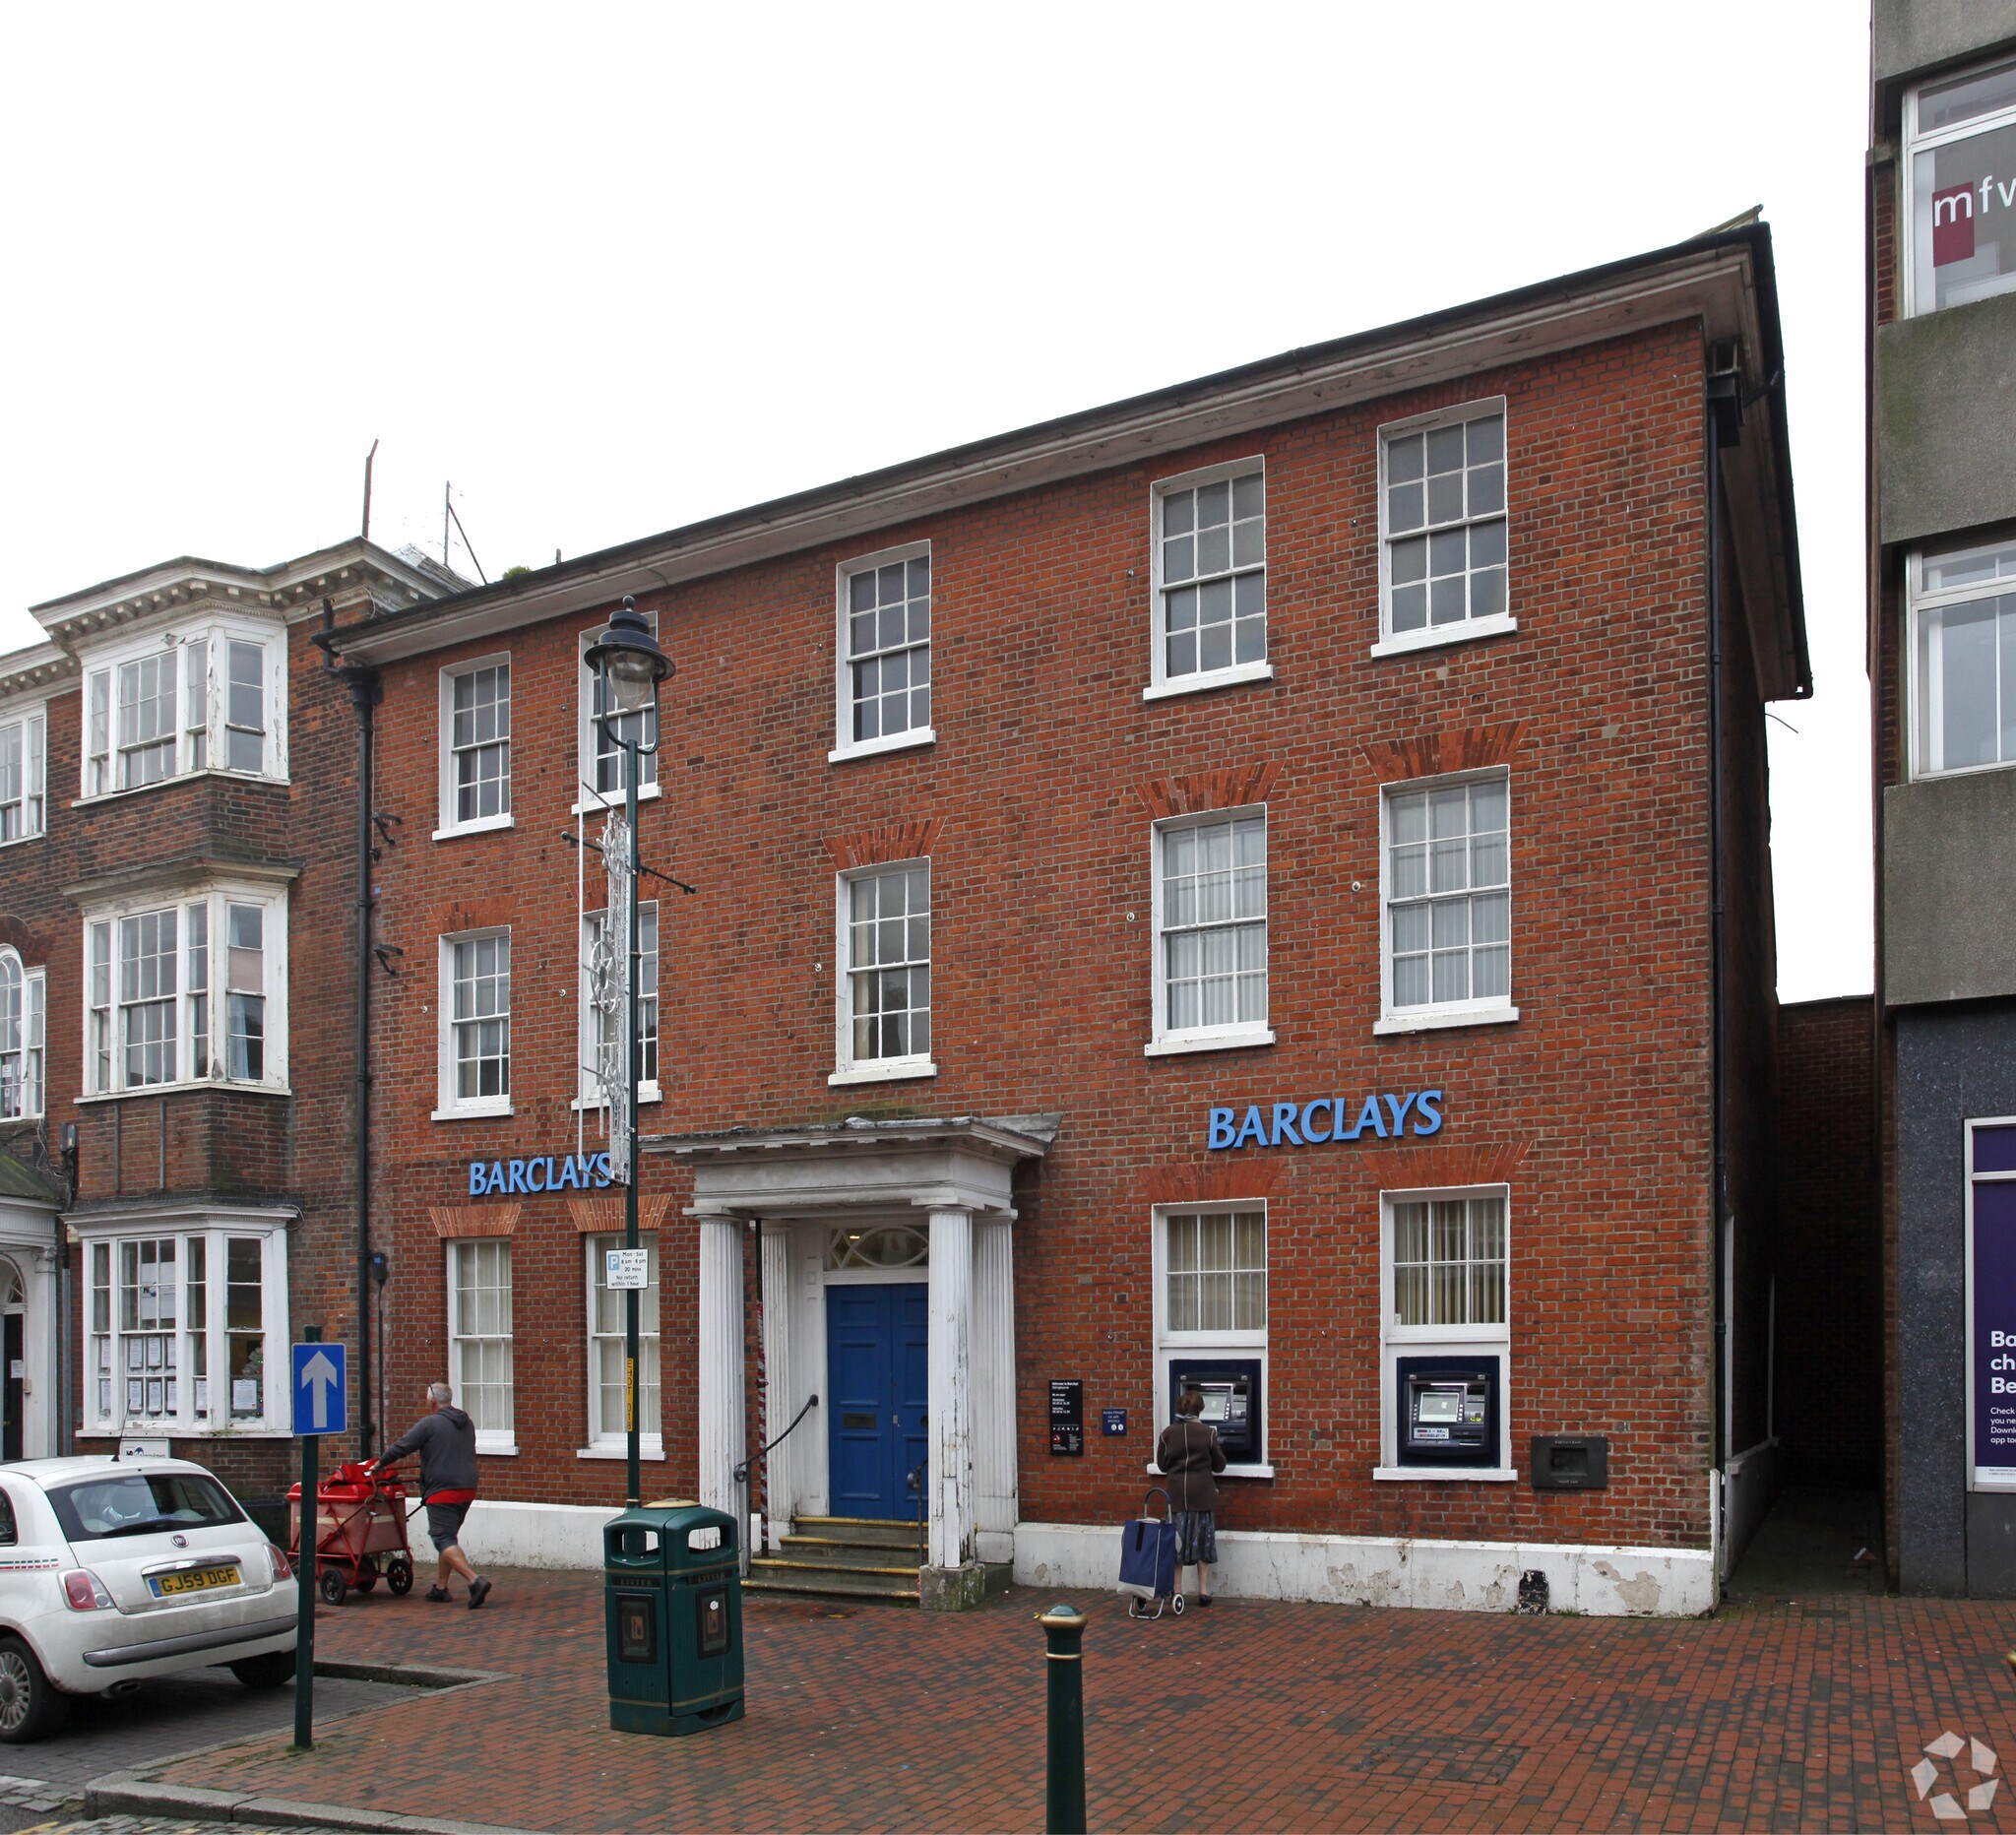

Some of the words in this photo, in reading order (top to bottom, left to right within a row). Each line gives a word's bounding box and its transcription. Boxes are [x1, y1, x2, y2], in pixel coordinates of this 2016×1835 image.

[1208, 1090, 1442, 1150] BARCLAYS
[469, 1152, 612, 1196] BARCLAYS
[610, 1256, 618, 1269] P
[1990, 1353, 2016, 1370] ch
[1990, 1376, 2016, 1394] Be
[160, 1573, 205, 1592] GJ59
[208, 1568, 235, 1585] DGF
[620, 1577, 653, 1586] LITTER
